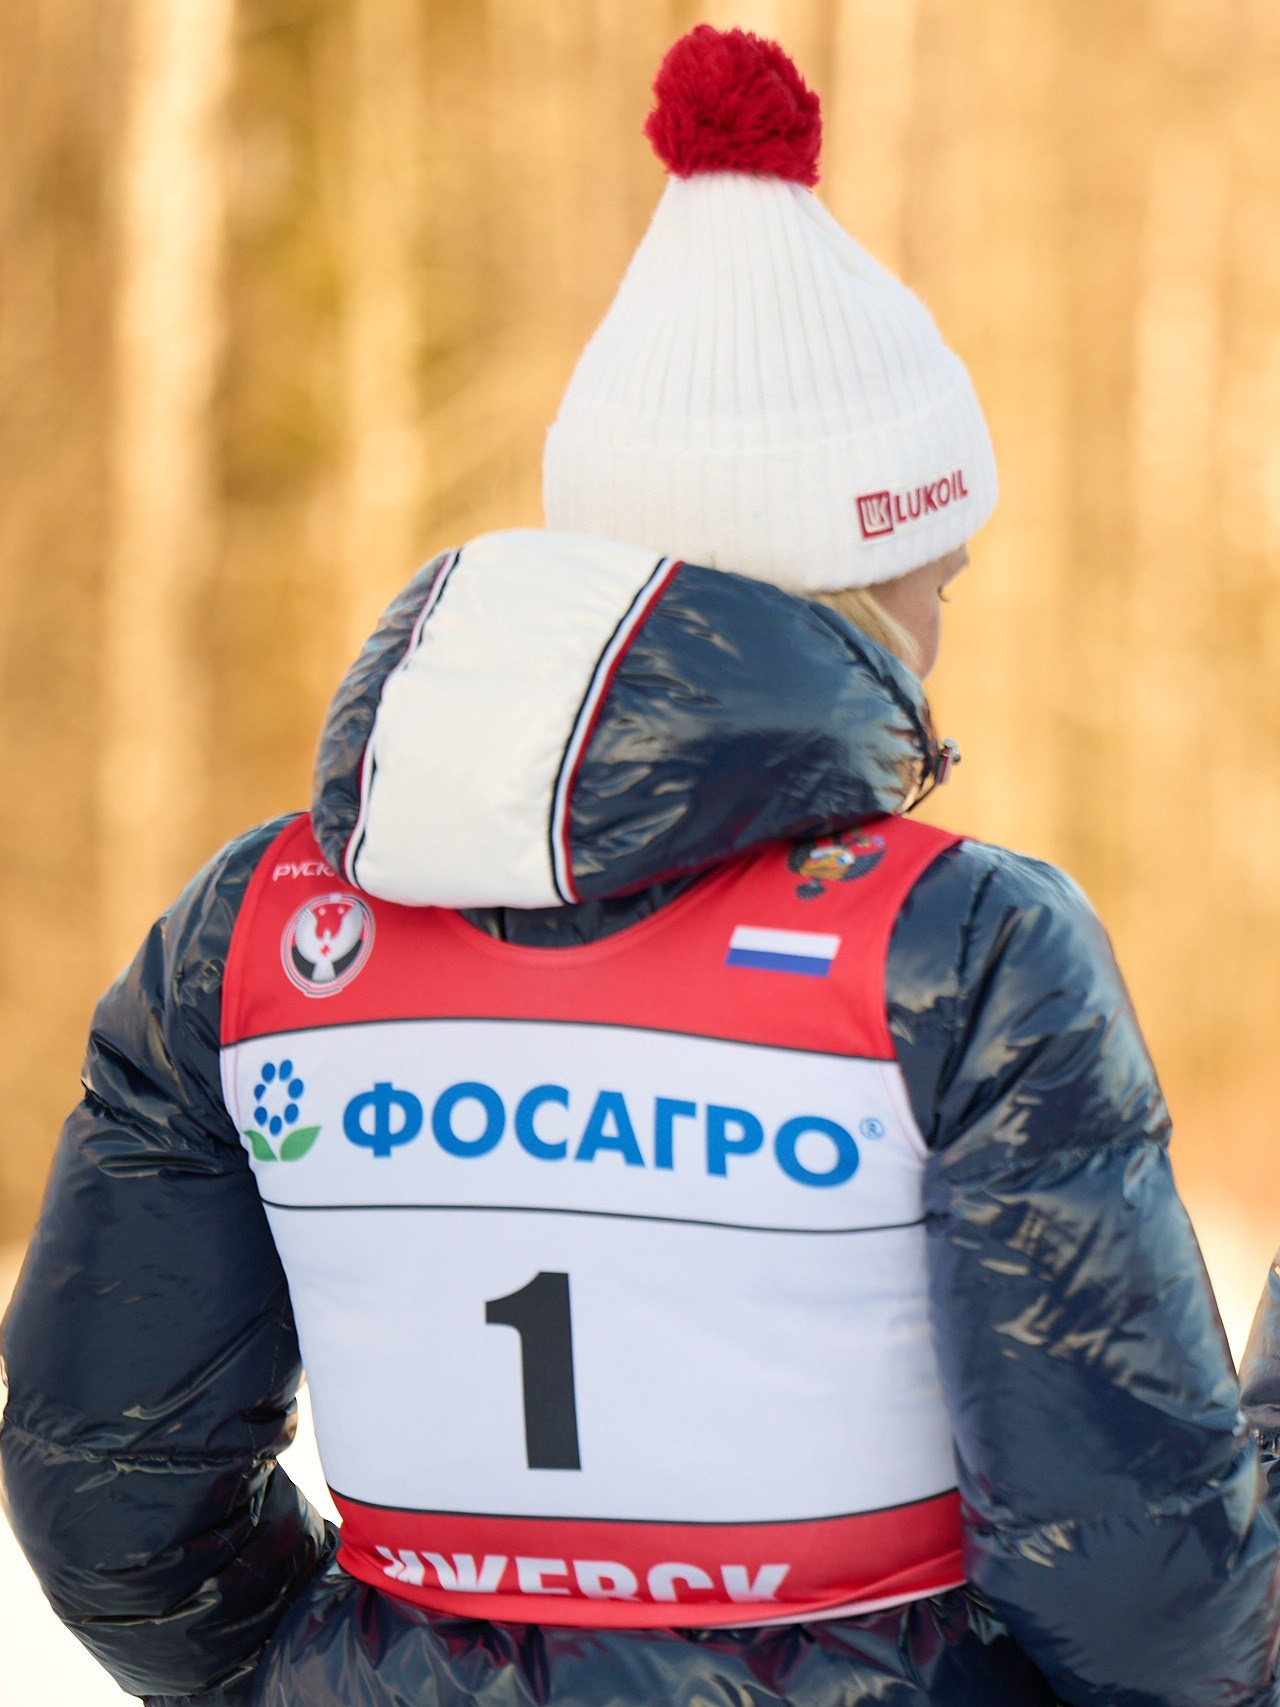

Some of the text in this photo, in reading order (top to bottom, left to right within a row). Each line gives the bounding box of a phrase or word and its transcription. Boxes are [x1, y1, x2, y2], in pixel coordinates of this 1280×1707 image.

[895, 470, 968, 522] LUKOIL
[342, 1081, 860, 1187] ФОСАГРО
[485, 1270, 582, 1470] 1
